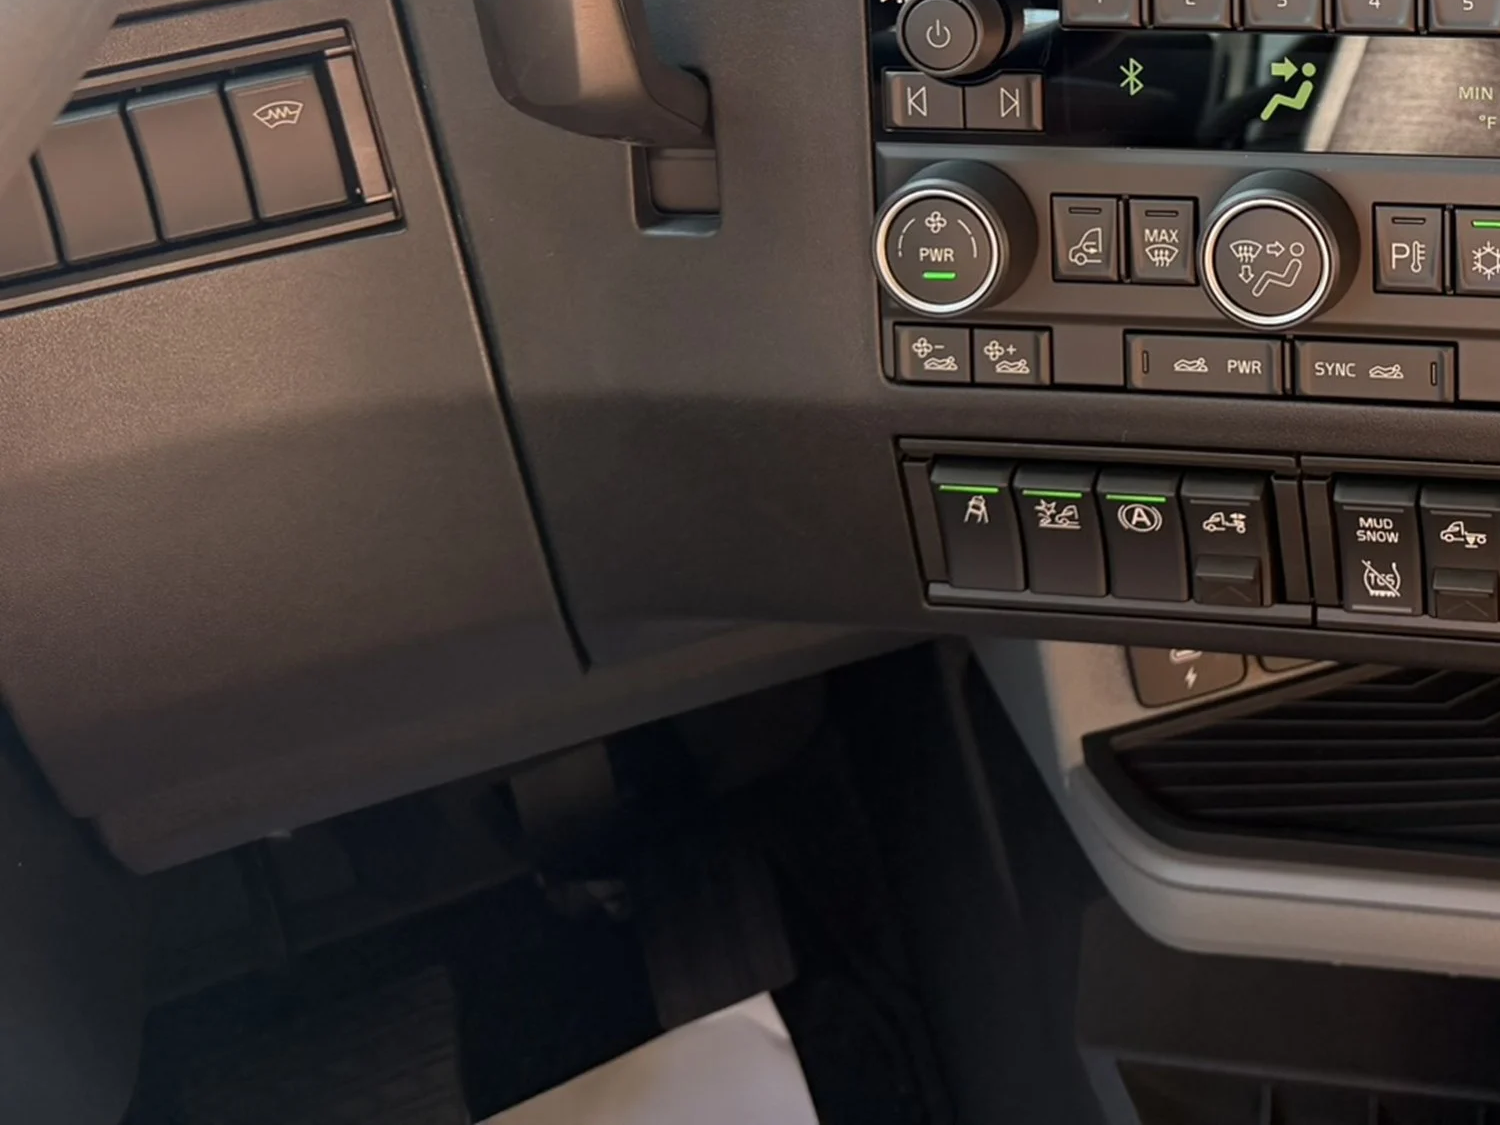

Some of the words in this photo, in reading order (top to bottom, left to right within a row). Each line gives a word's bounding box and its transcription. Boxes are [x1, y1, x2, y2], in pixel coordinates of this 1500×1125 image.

[1458, 86, 1495, 101] MIN
[1144, 228, 1180, 243] MAX
[918, 247, 955, 263] PWR
[1226, 359, 1262, 375] PWR
[1314, 362, 1356, 378] SYNC
[1358, 516, 1394, 530] MUD
[1355, 529, 1400, 544] SNOW
